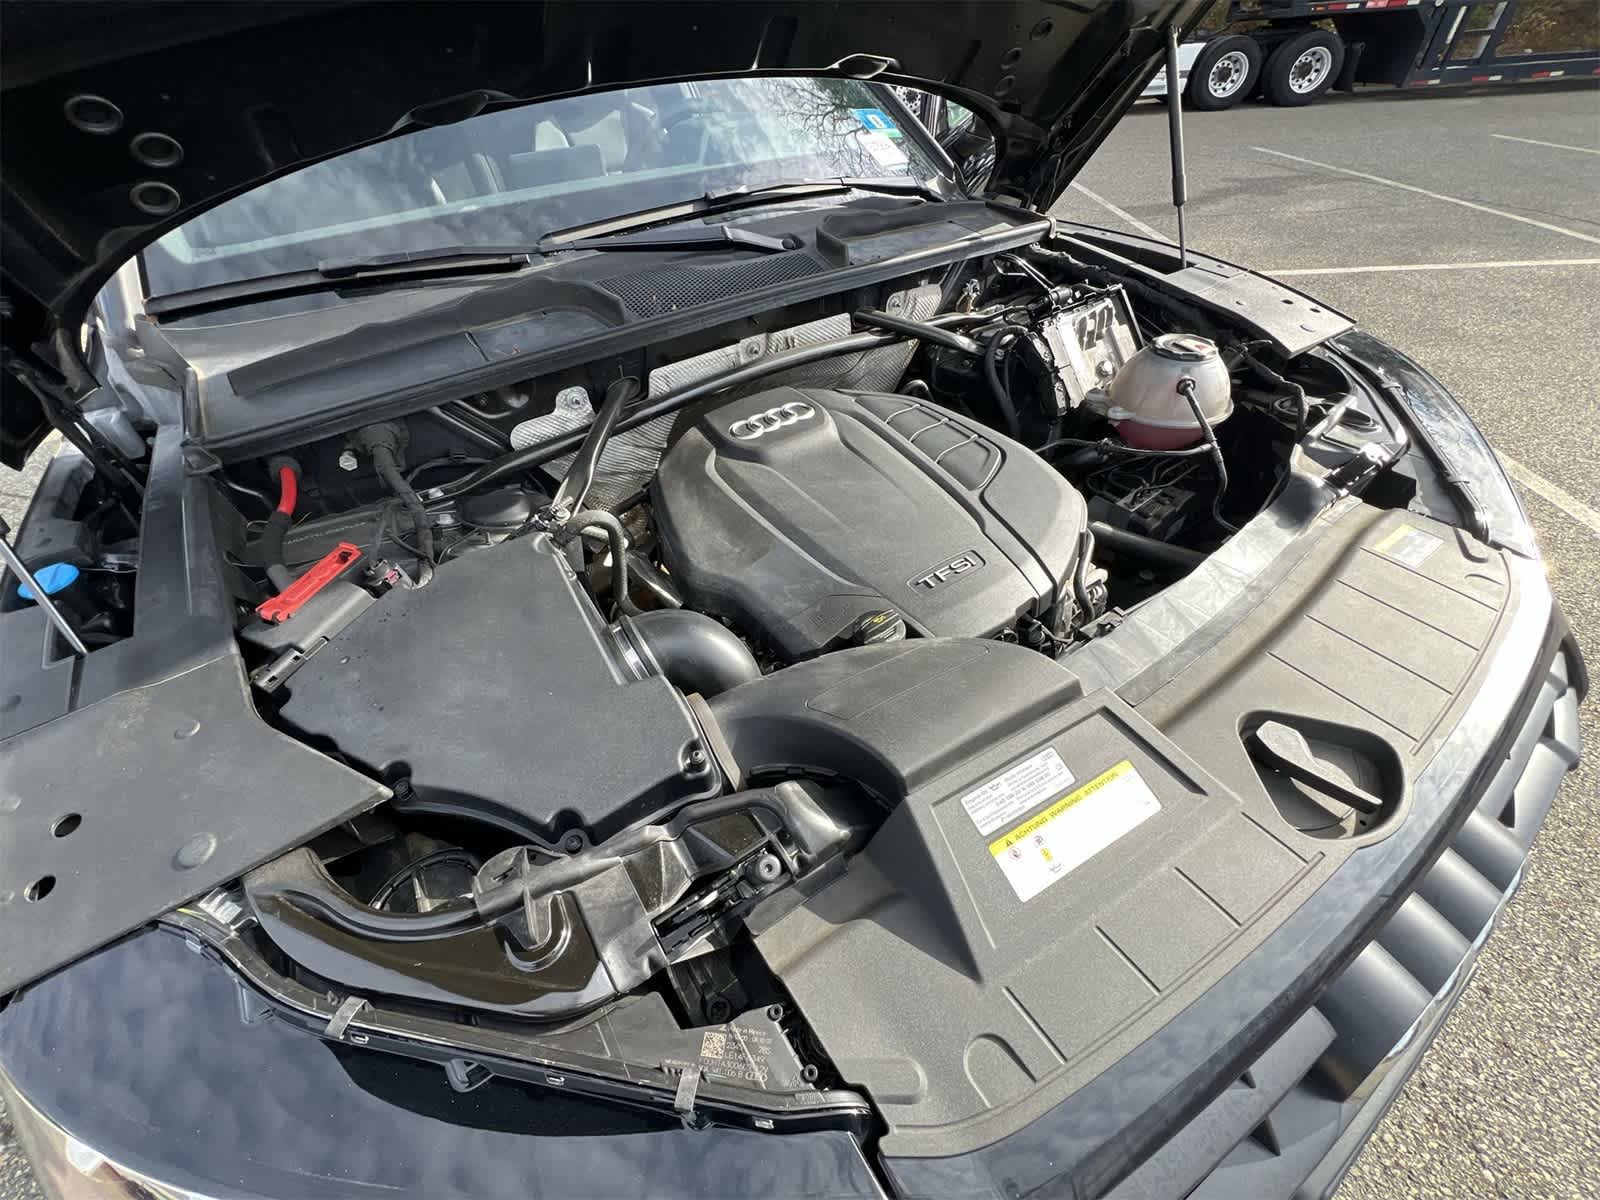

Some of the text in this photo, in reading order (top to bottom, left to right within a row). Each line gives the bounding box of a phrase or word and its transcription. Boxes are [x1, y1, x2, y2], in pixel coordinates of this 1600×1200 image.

[914, 555, 977, 589] TFSI
[1014, 816, 1048, 841] ACHTUNG
[1048, 794, 1082, 819] WARNING
